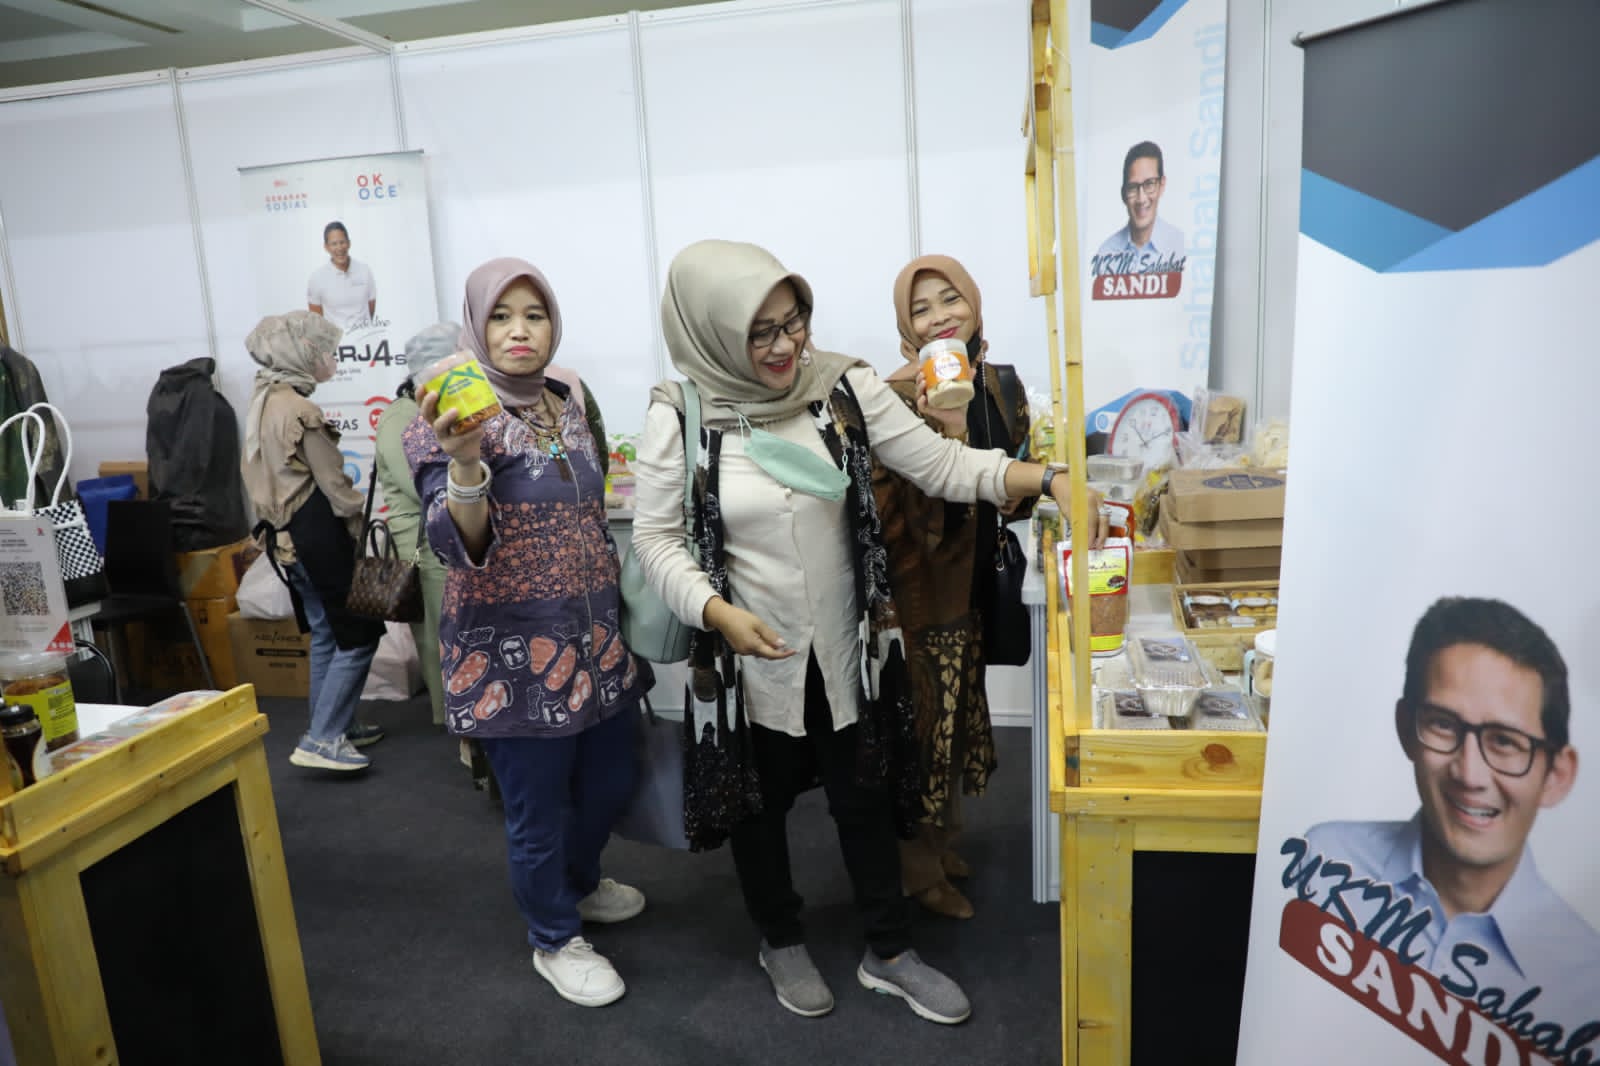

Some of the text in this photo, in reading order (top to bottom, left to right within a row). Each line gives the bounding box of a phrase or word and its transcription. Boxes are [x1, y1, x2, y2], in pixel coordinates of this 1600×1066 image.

[357, 173, 383, 188] OK
[358, 185, 397, 201] OCE
[1180, 23, 1225, 371] Sahabat Sandi
[1091, 250, 1135, 278] UKM
[1103, 274, 1169, 297] SANDI
[1280, 837, 1600, 1066] UKM Sahab
[1316, 922, 1560, 1066] SAND
